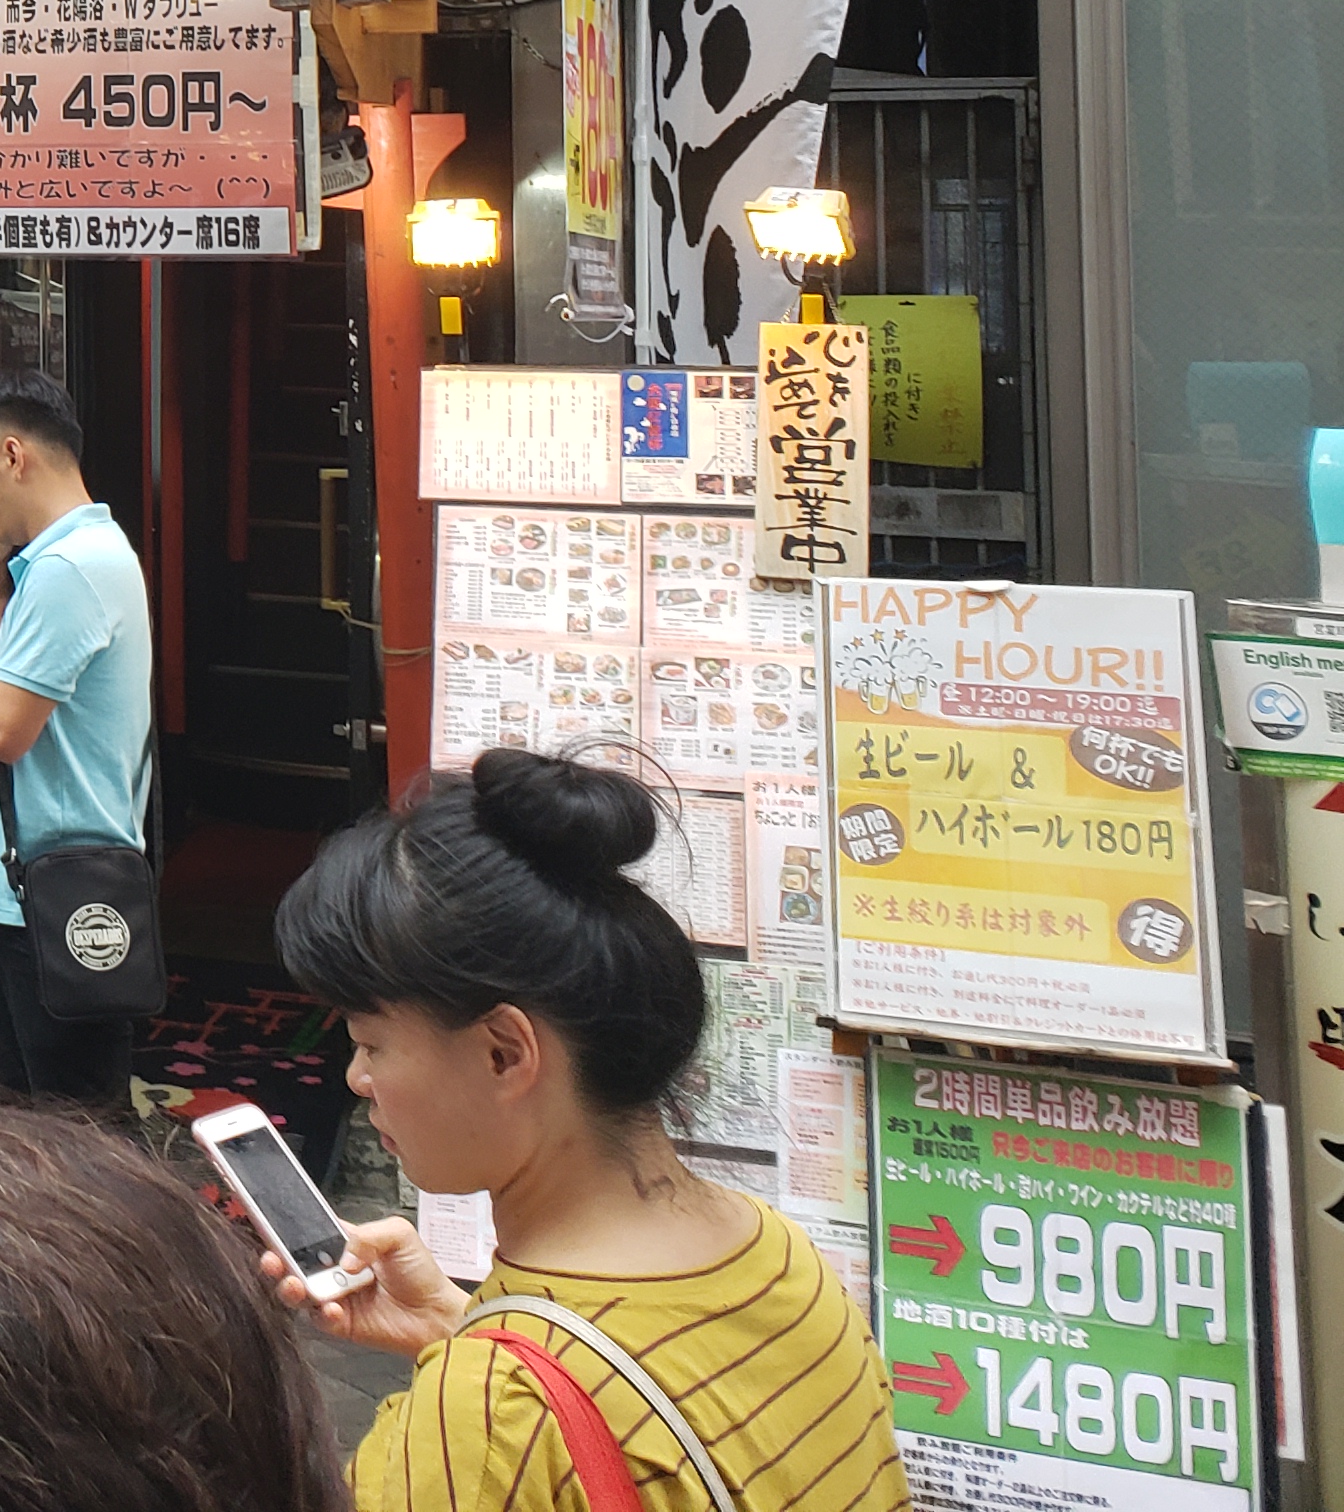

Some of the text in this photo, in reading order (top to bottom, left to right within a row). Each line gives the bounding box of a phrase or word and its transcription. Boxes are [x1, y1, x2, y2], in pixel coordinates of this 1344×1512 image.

[766, 414, 859, 573] 営業中
[833, 585, 1039, 632] HAPPY
[955, 640, 1164, 691] HOUR!!
[1243, 649, 1311, 670] English
[856, 729, 1036, 790] 生ビール &
[1082, 726, 1185, 772] 何杯でも
[1094, 753, 1154, 788] OK!!
[848, 833, 903, 862] 限定
[1131, 904, 1185, 957] 得
[914, 1068, 1201, 1148] 2時間単品飲み放題
[980, 1203, 1228, 1345] 980円
[977, 1346, 1240, 1483] 1480円
